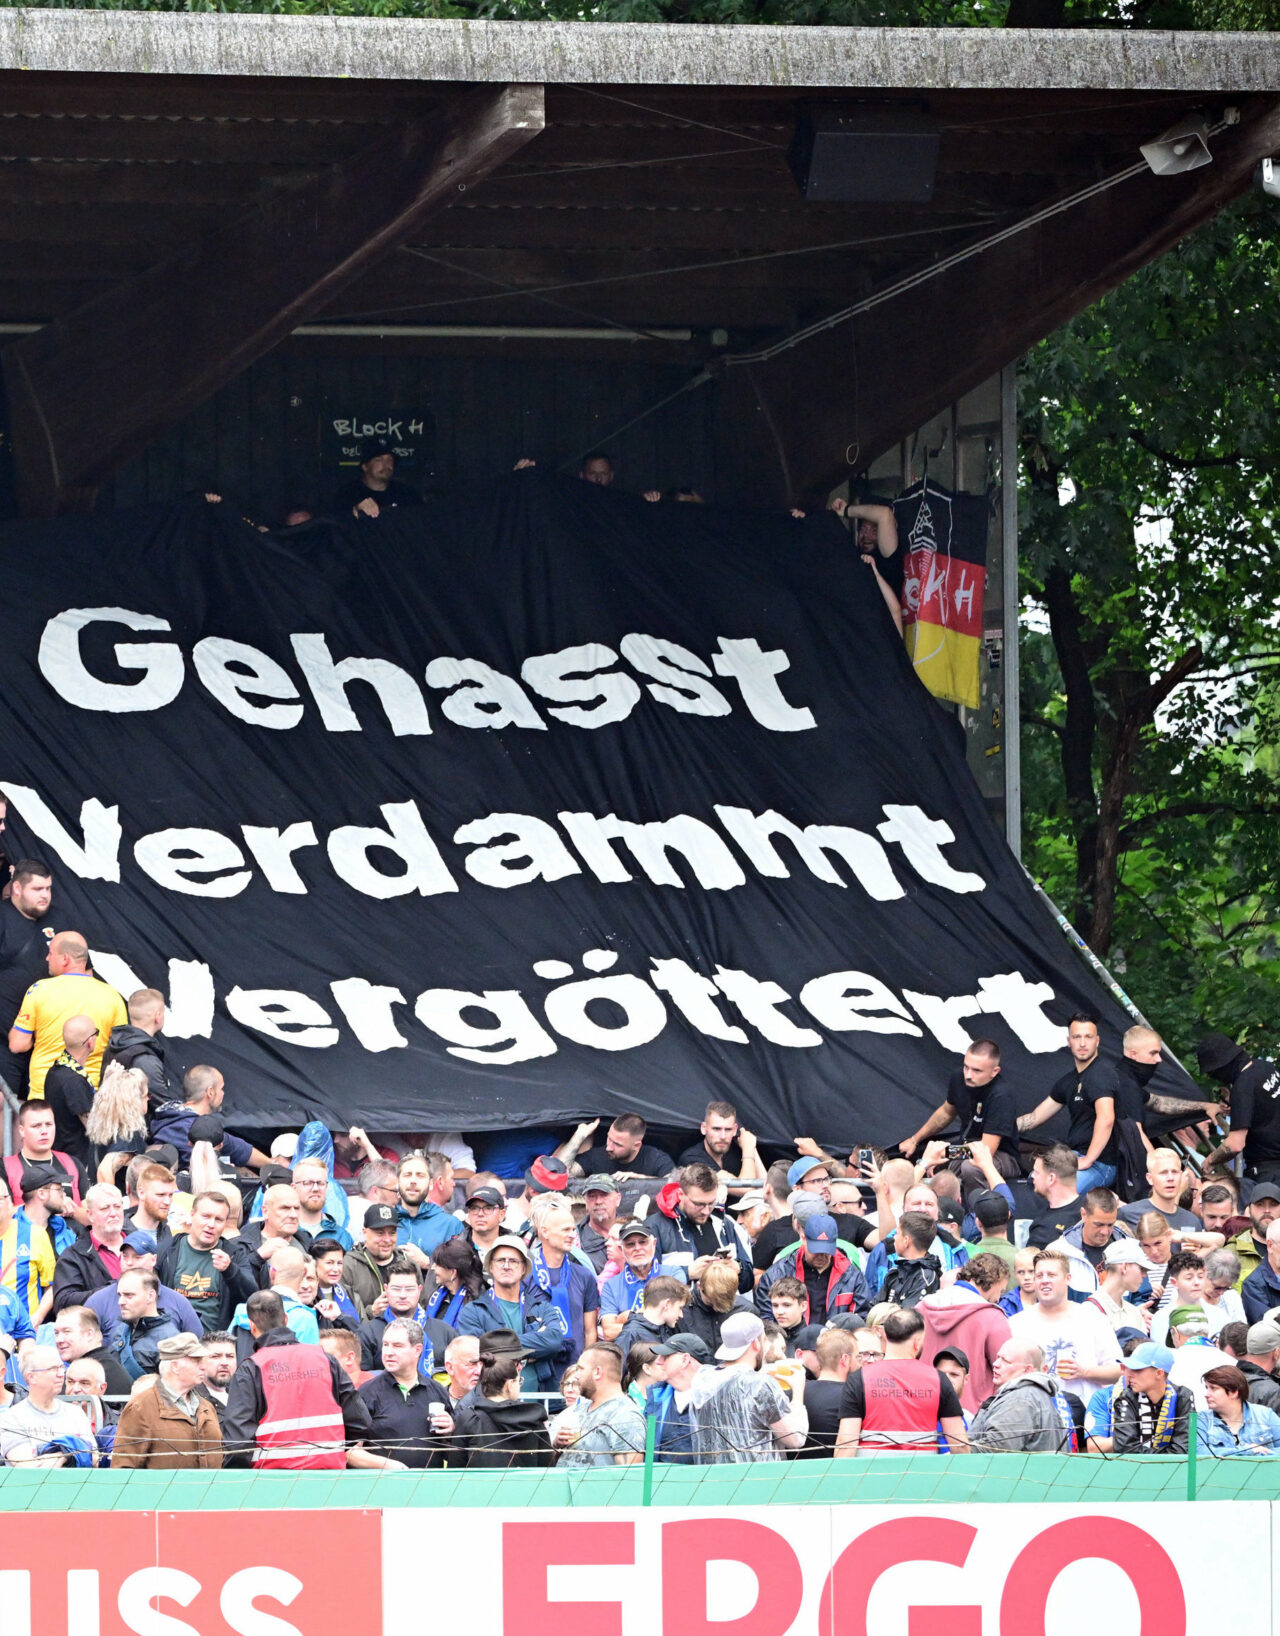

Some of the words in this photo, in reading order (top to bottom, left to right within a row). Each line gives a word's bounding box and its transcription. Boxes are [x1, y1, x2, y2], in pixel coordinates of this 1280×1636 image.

[38, 606, 817, 737] Gehasst
[88, 949, 1070, 1065] Vergöttert
[268, 1370, 325, 1384] SICHERHEIT
[871, 1388, 934, 1399] SICHERHEIT
[876, 1379, 896, 1388] CSS
[502, 1516, 1187, 1636] ERGO
